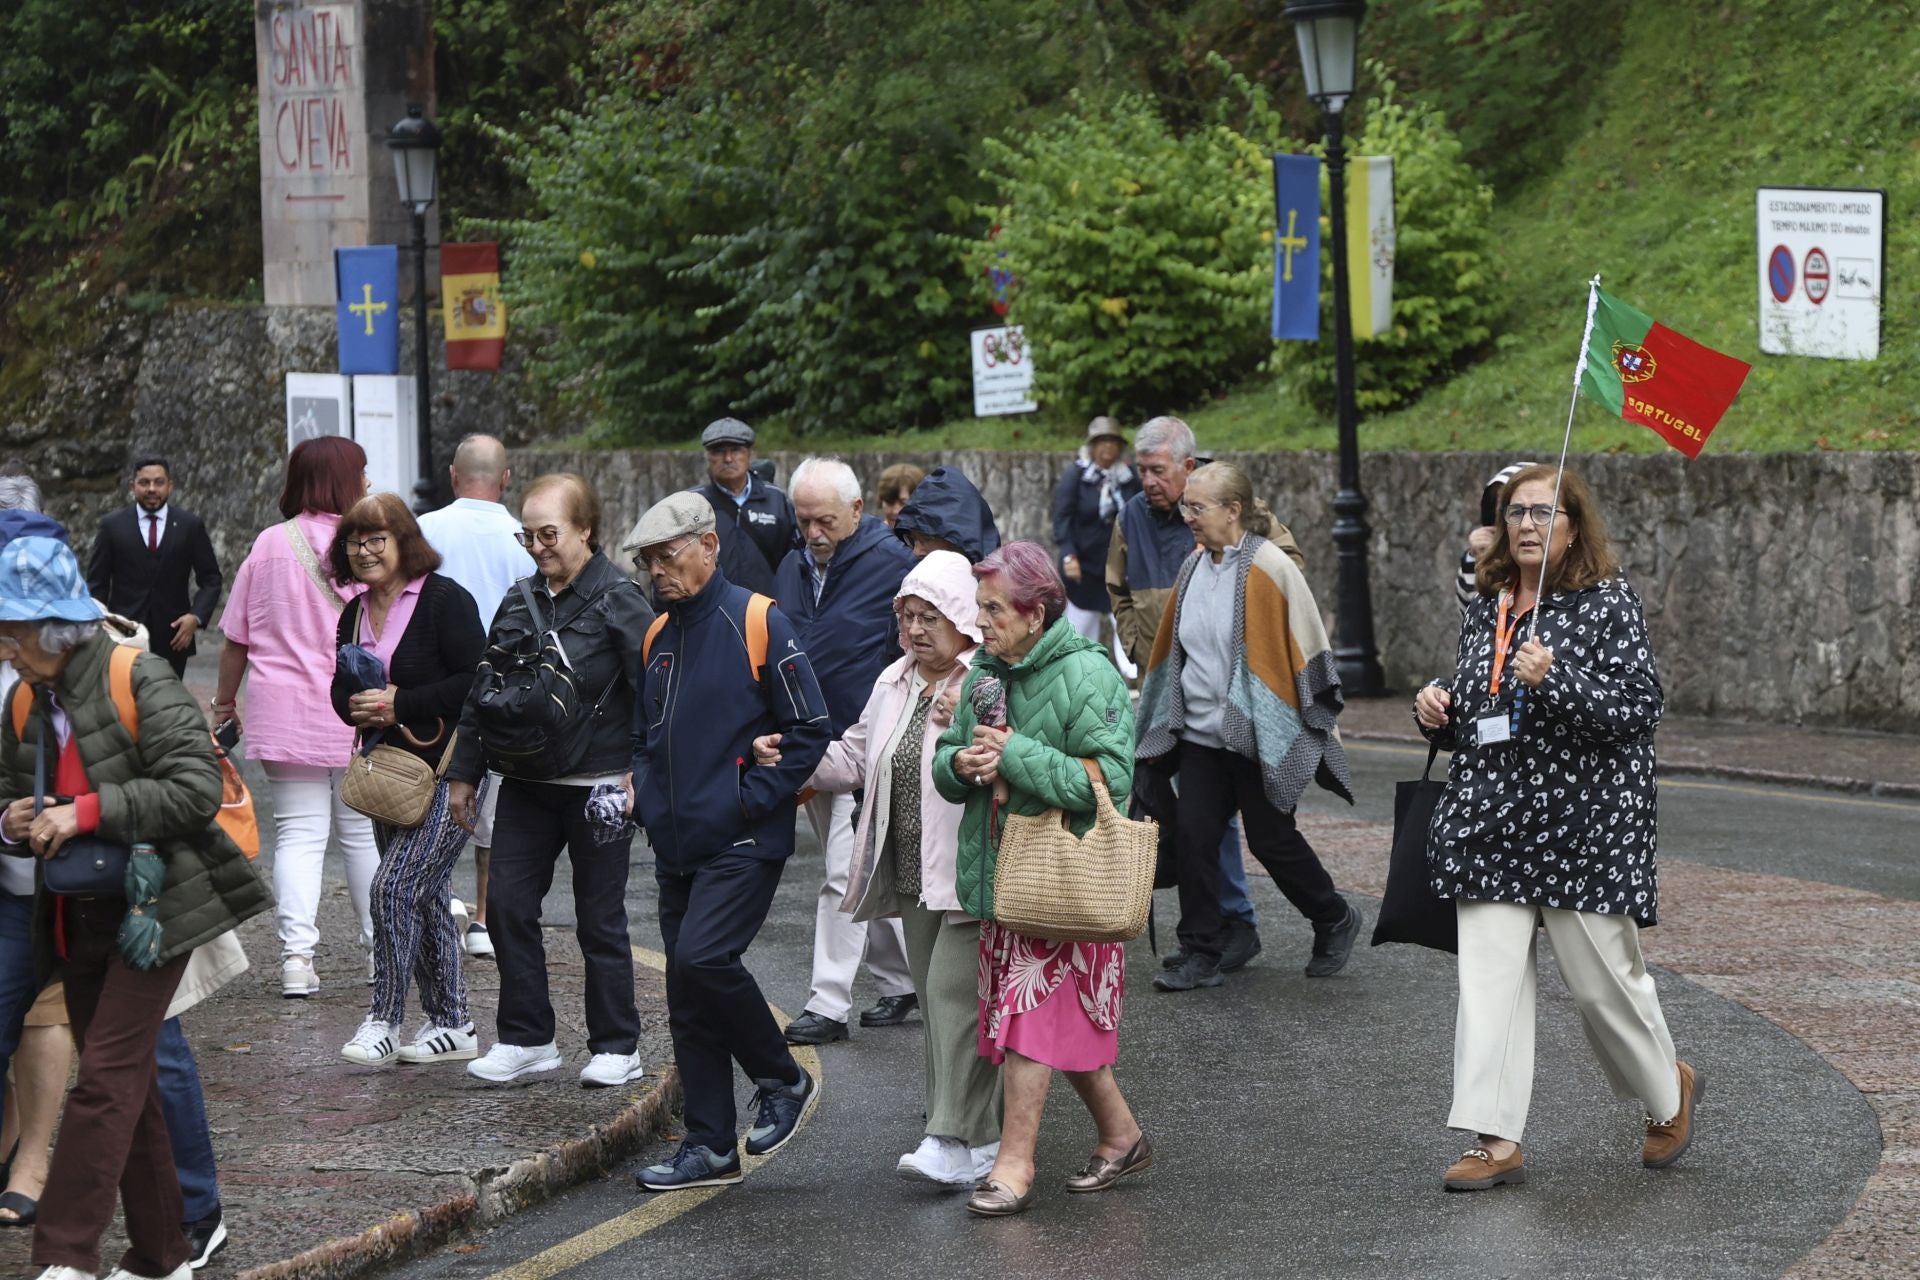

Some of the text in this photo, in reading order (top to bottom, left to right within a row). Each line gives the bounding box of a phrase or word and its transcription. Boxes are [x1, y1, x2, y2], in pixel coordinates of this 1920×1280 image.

[274, 12, 349, 86] SANTA
[276, 97, 350, 172] CVEVA
[1768, 200, 1872, 215] ESTACIONAMIENTO LIMITADO
[1771, 220, 1797, 232] TIEMPO
[1628, 396, 1701, 442] PORTUGAL
